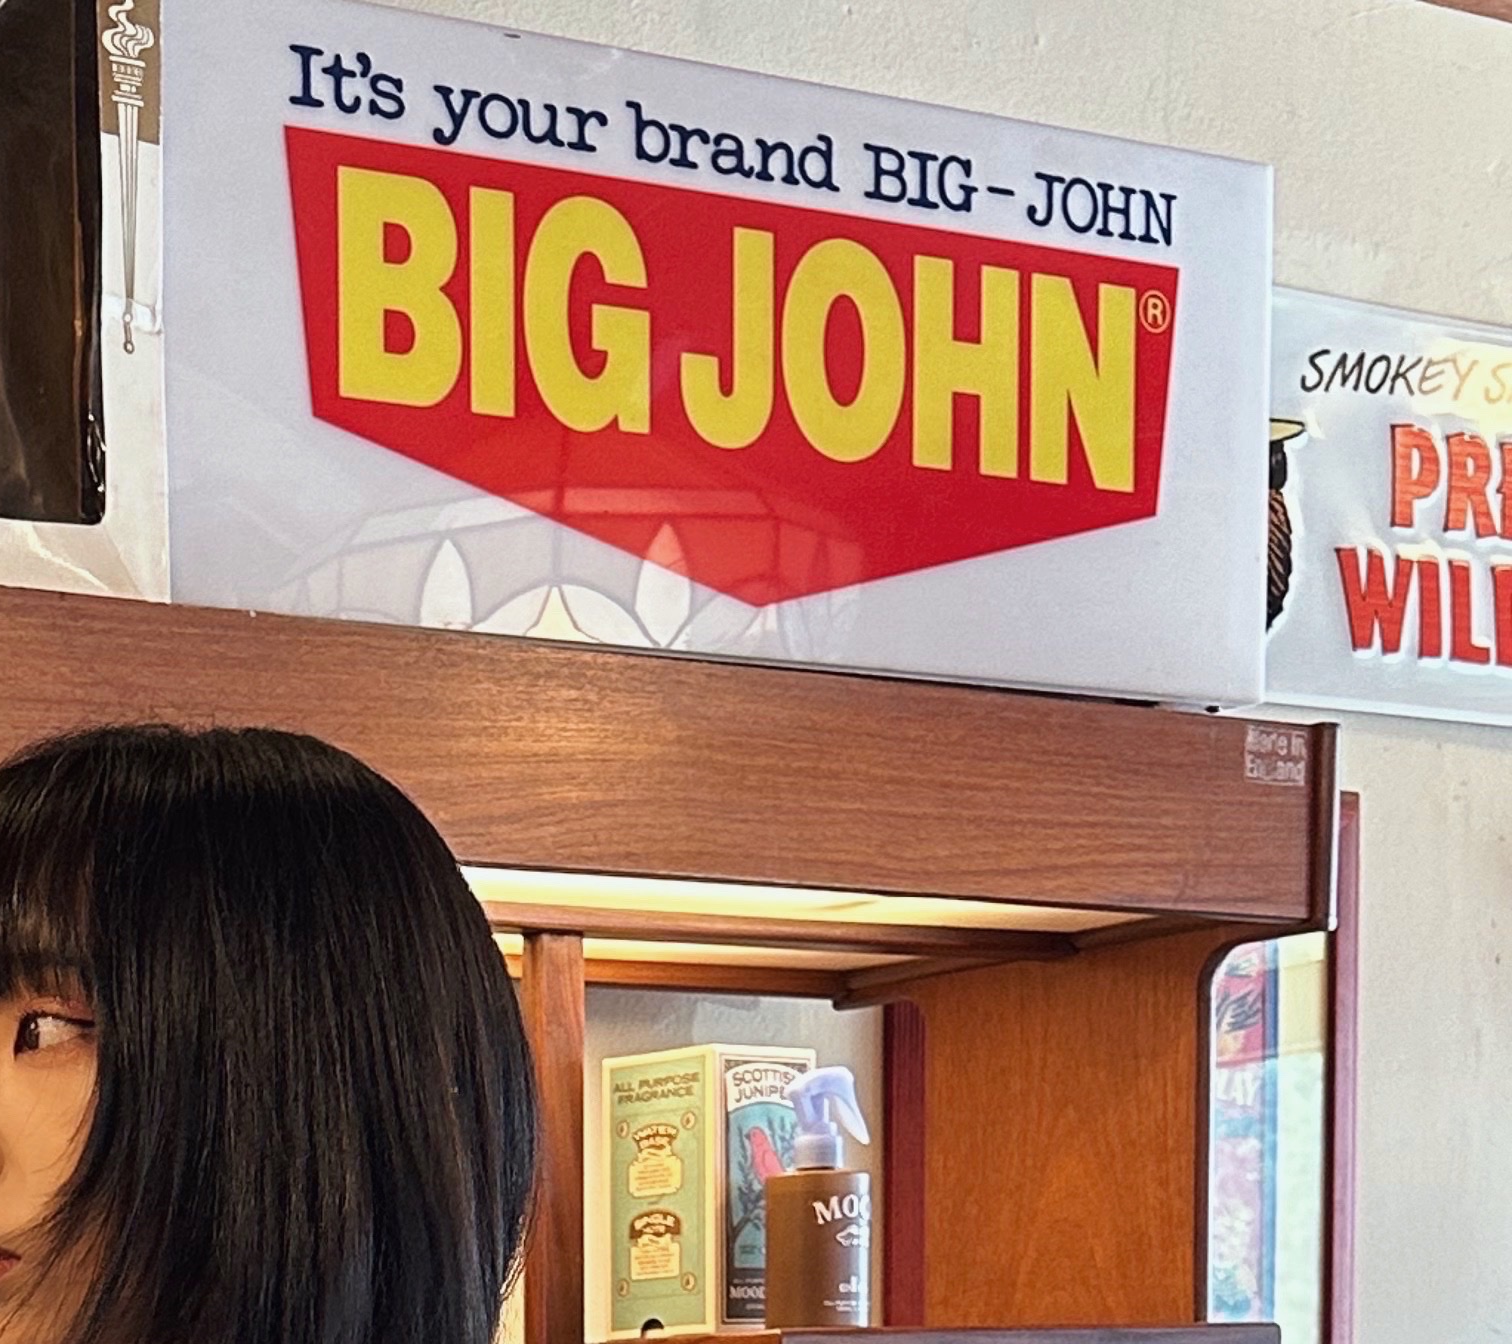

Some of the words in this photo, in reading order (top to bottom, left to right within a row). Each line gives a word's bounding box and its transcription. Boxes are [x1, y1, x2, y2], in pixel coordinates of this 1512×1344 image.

[288, 42, 407, 122] It's
[432, 85, 609, 152] your
[626, 101, 840, 195] brand
[336, 163, 653, 436] BIG
[680, 226, 1137, 494] JOHN
[1300, 348, 1479, 403] SMOKEY
[732, 1068, 796, 1087] SCOTTIS
